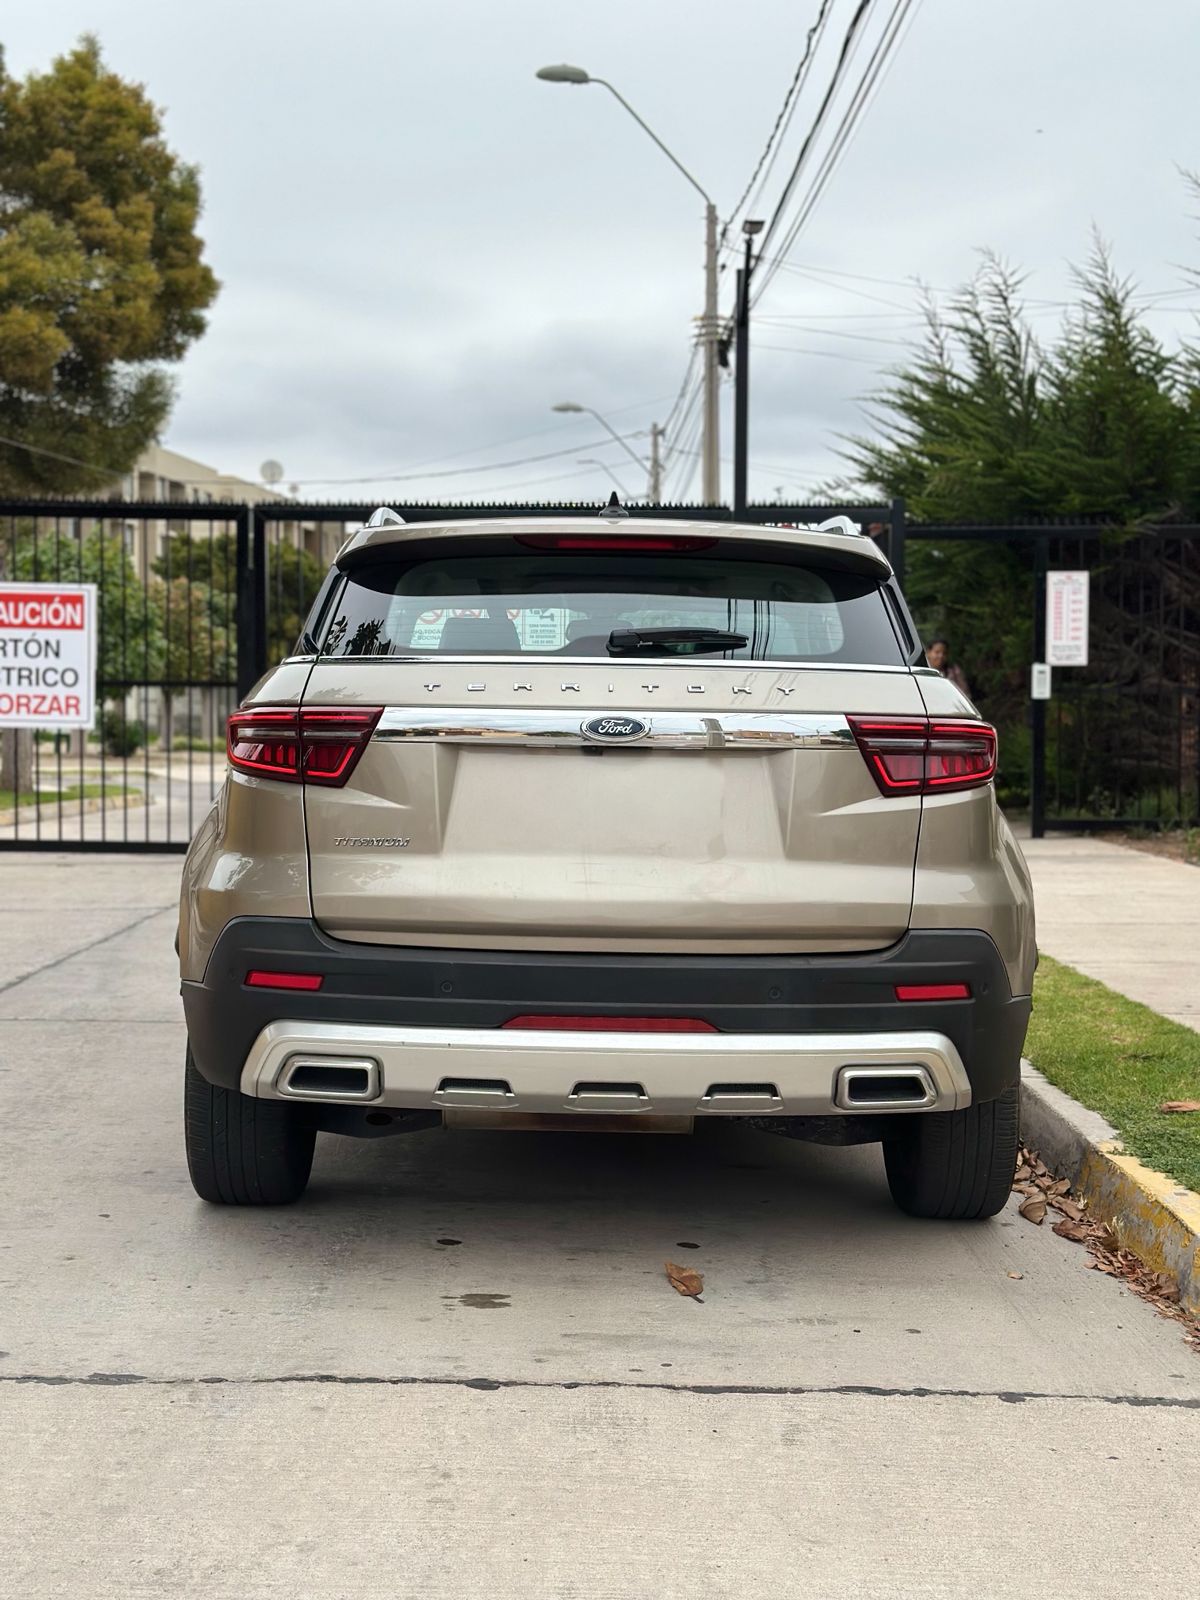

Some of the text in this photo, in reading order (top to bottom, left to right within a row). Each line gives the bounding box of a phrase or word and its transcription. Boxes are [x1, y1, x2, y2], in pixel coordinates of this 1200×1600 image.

[0, 666, 79, 688] TRICO
[424, 682, 795, 695] TERRITORY
[597, 716, 633, 735] Ford
[334, 837, 411, 848] TITANIUM
